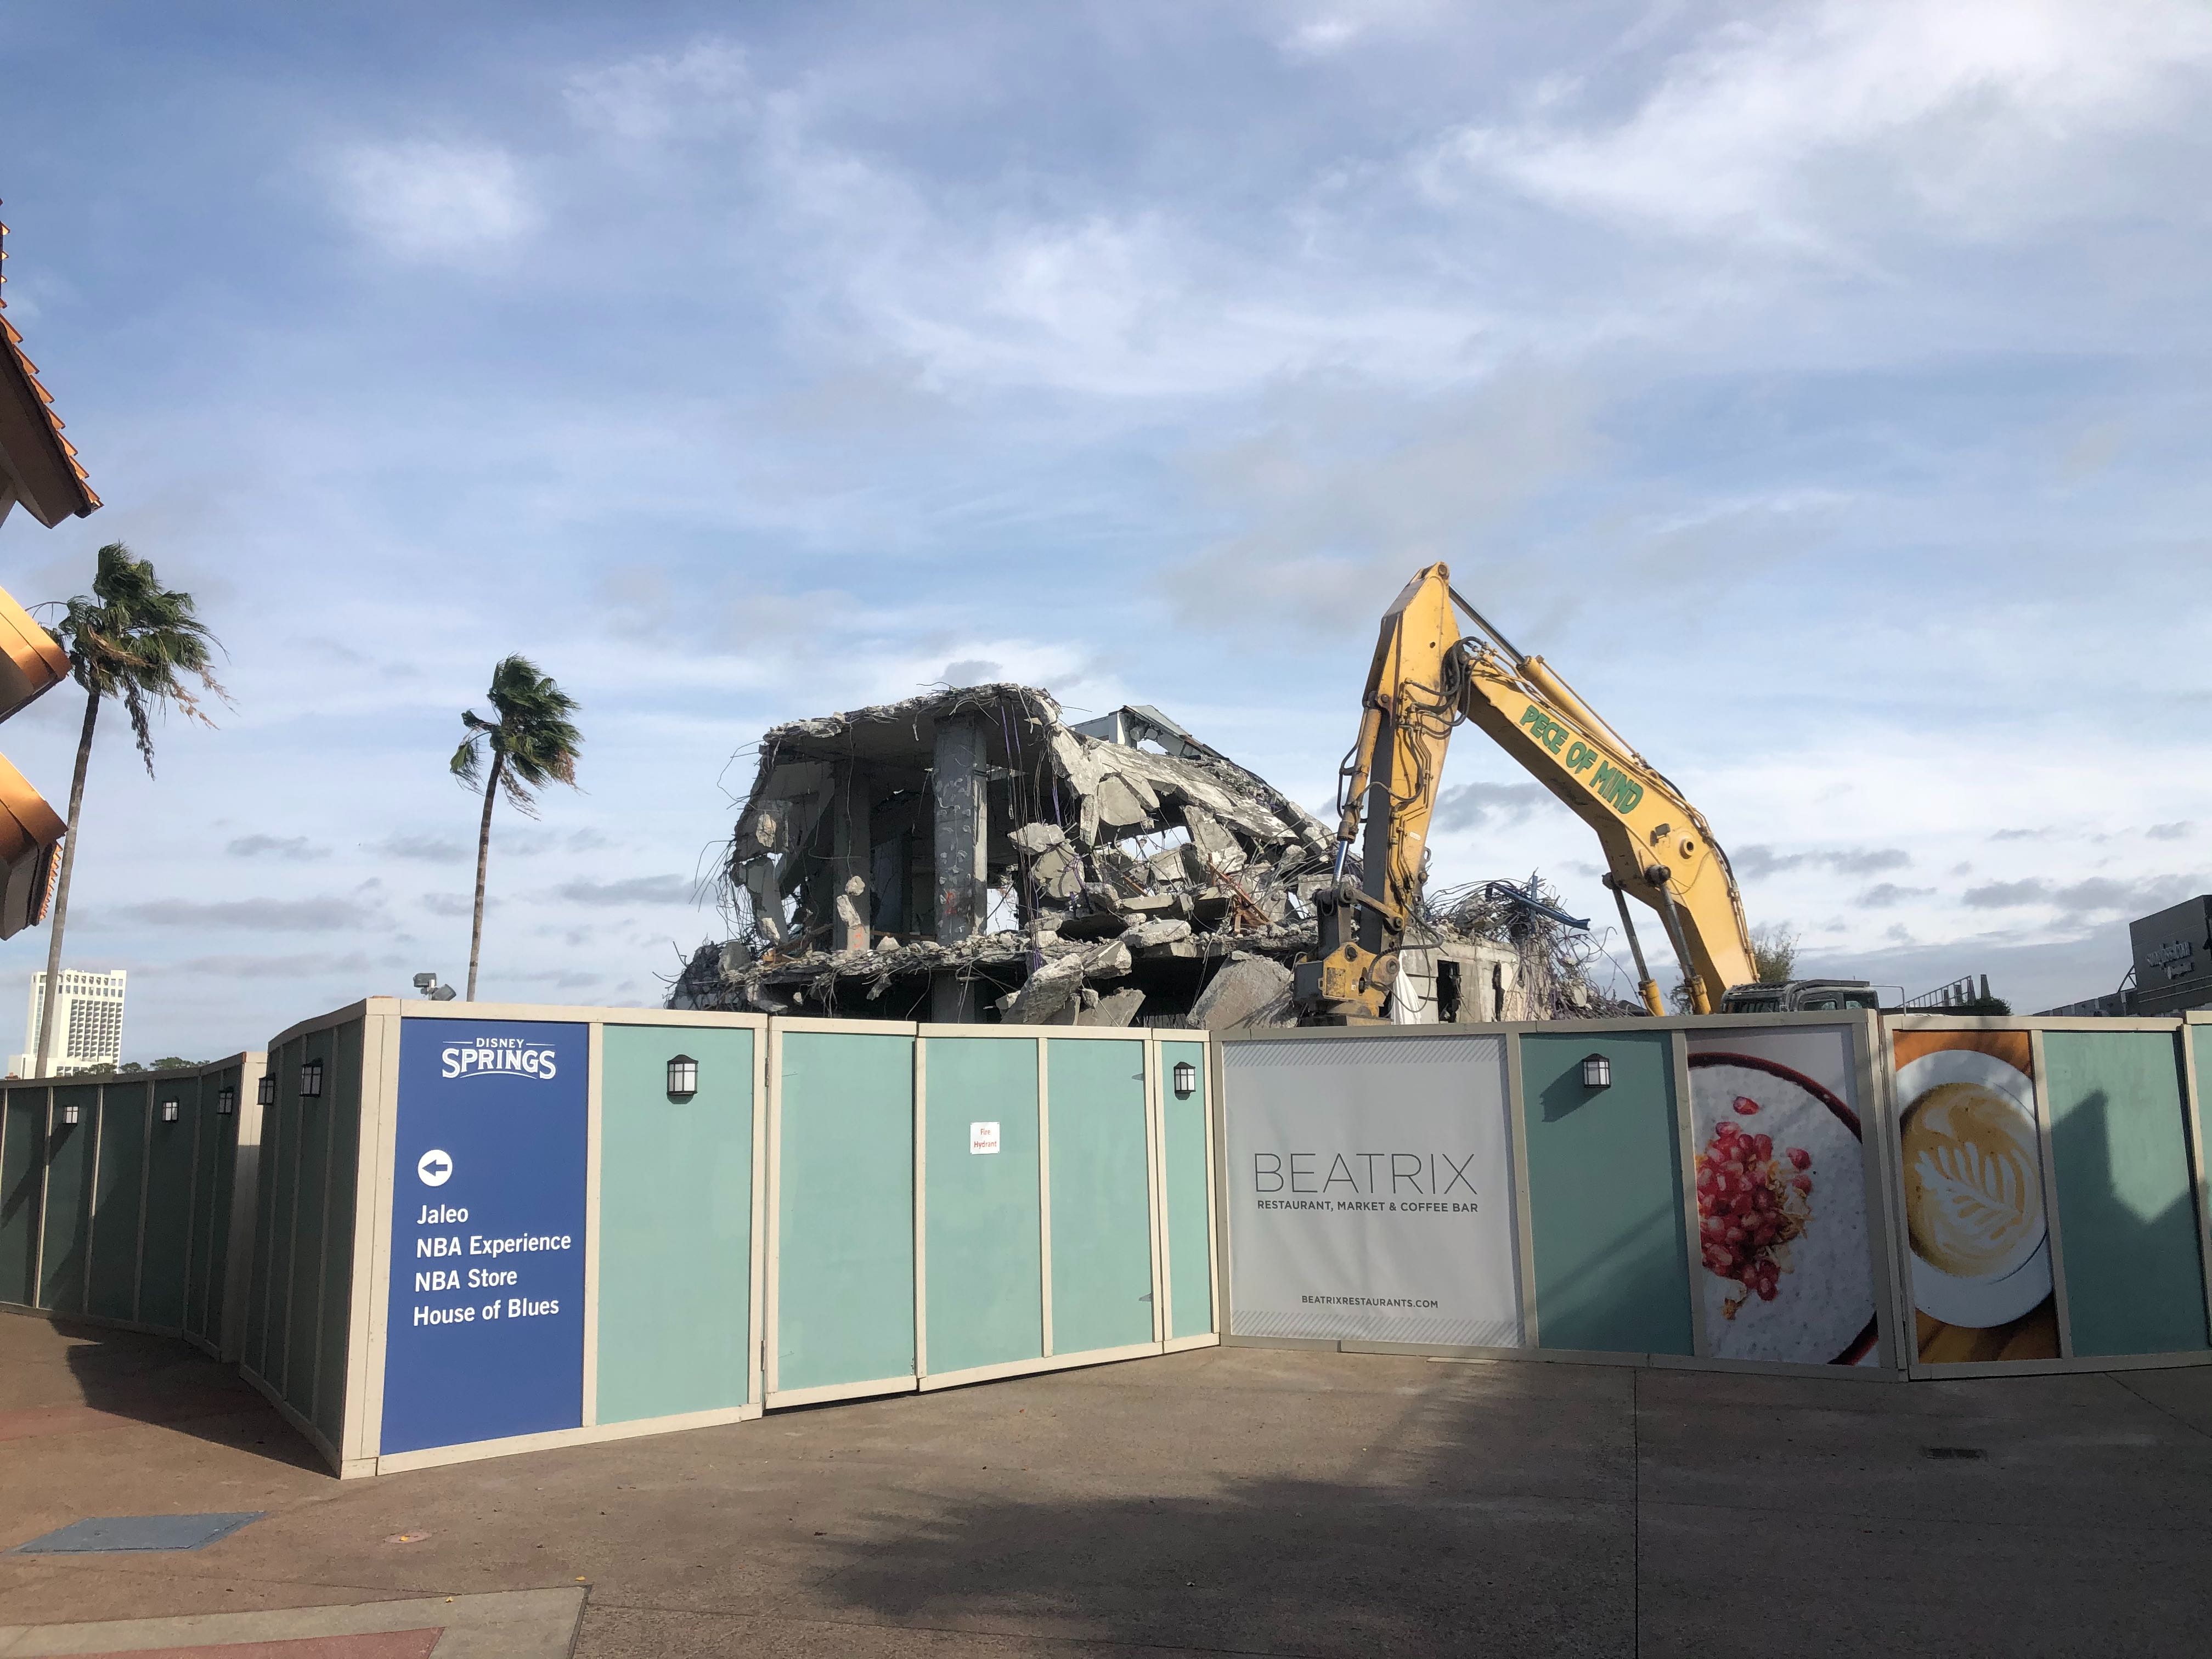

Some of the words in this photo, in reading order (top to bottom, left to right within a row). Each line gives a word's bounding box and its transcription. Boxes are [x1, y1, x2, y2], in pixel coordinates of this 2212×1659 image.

[1519, 704, 1569, 755] PECE
[1566, 741, 1598, 774] OF
[1589, 760, 1644, 814] MIND
[475, 1037, 524, 1048] DISNEY
[442, 1048, 556, 1080] SPRINGS
[974, 1141, 997, 1149] Hydrant
[1254, 1153, 1479, 1195] BEATRIX
[417, 1204, 469, 1224] Jaleo
[1257, 1199, 1334, 1212] RESTAURANT,
[1337, 1201, 1385, 1212] MARKET
[1389, 1201, 1397, 1212] &
[1400, 1202, 1449, 1212] COFFEE
[1452, 1203, 1479, 1213] BAR
[416, 1237, 462, 1258] NBA
[470, 1233, 572, 1259] Experience
[415, 1269, 461, 1292] NBA
[467, 1268, 517, 1288] Store
[413, 1306, 475, 1327] House
[482, 1299, 501, 1320] of
[508, 1297, 560, 1318] Blues
[1301, 1295, 1438, 1308] BEATRIXRESTAURANTS.COM
